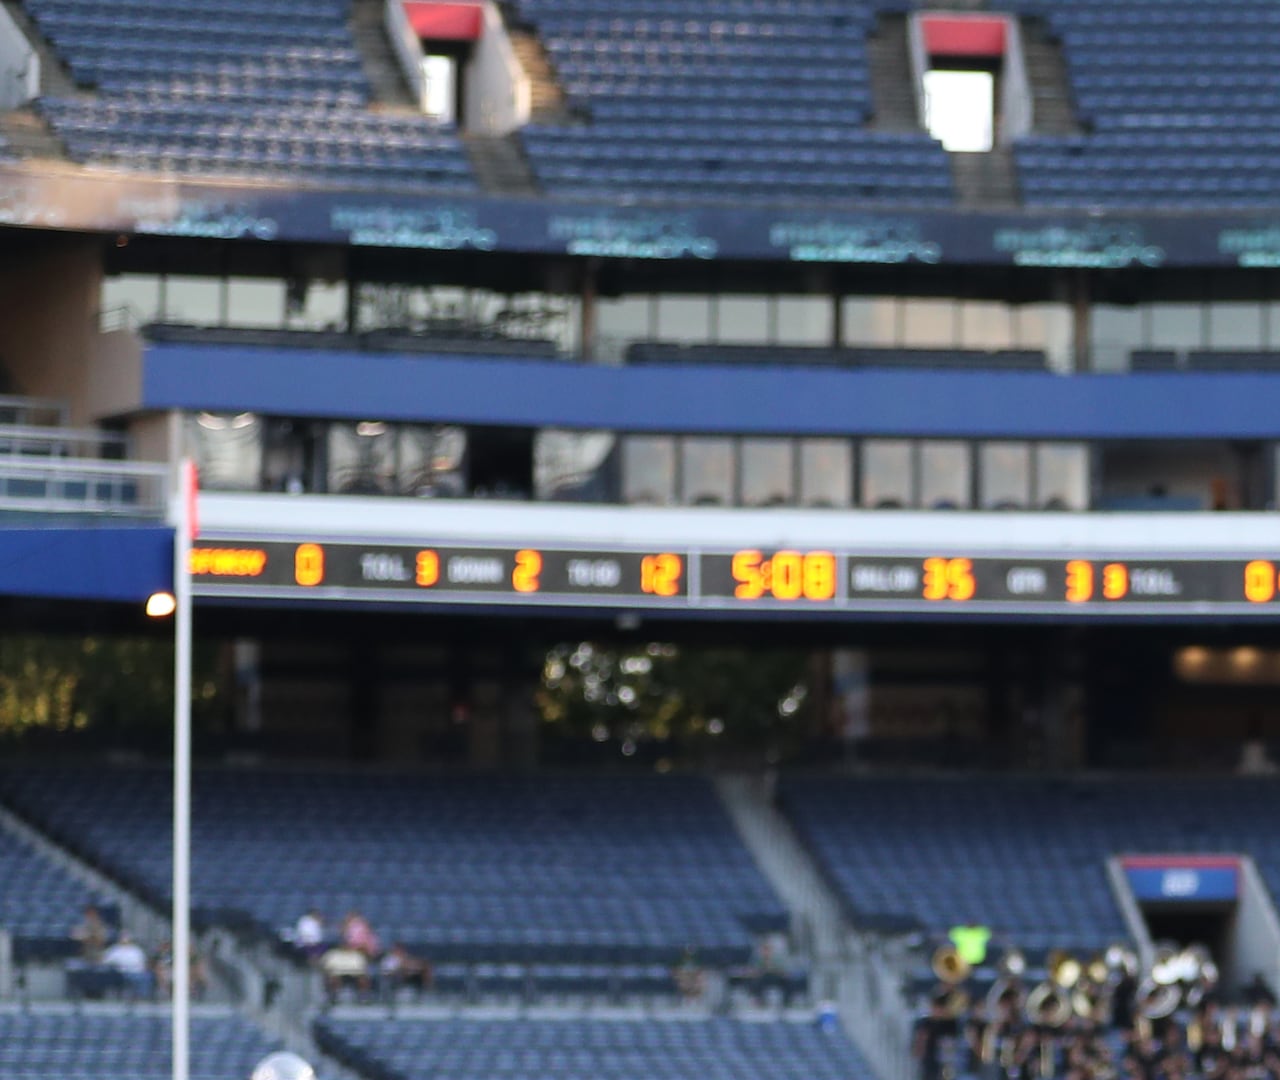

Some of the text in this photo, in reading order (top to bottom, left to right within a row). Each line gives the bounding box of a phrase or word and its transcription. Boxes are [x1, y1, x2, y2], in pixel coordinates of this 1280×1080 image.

[295, 542, 325, 587] 0
[415, 549, 440, 588] 3
[512, 549, 542, 593] 2
[640, 552, 683, 597] 12
[731, 549, 836, 600] 5:08
[923, 557, 976, 601] 35
[1065, 559, 1094, 603] 3
[1103, 563, 1128, 599] 3
[1244, 560, 1276, 603] 0
